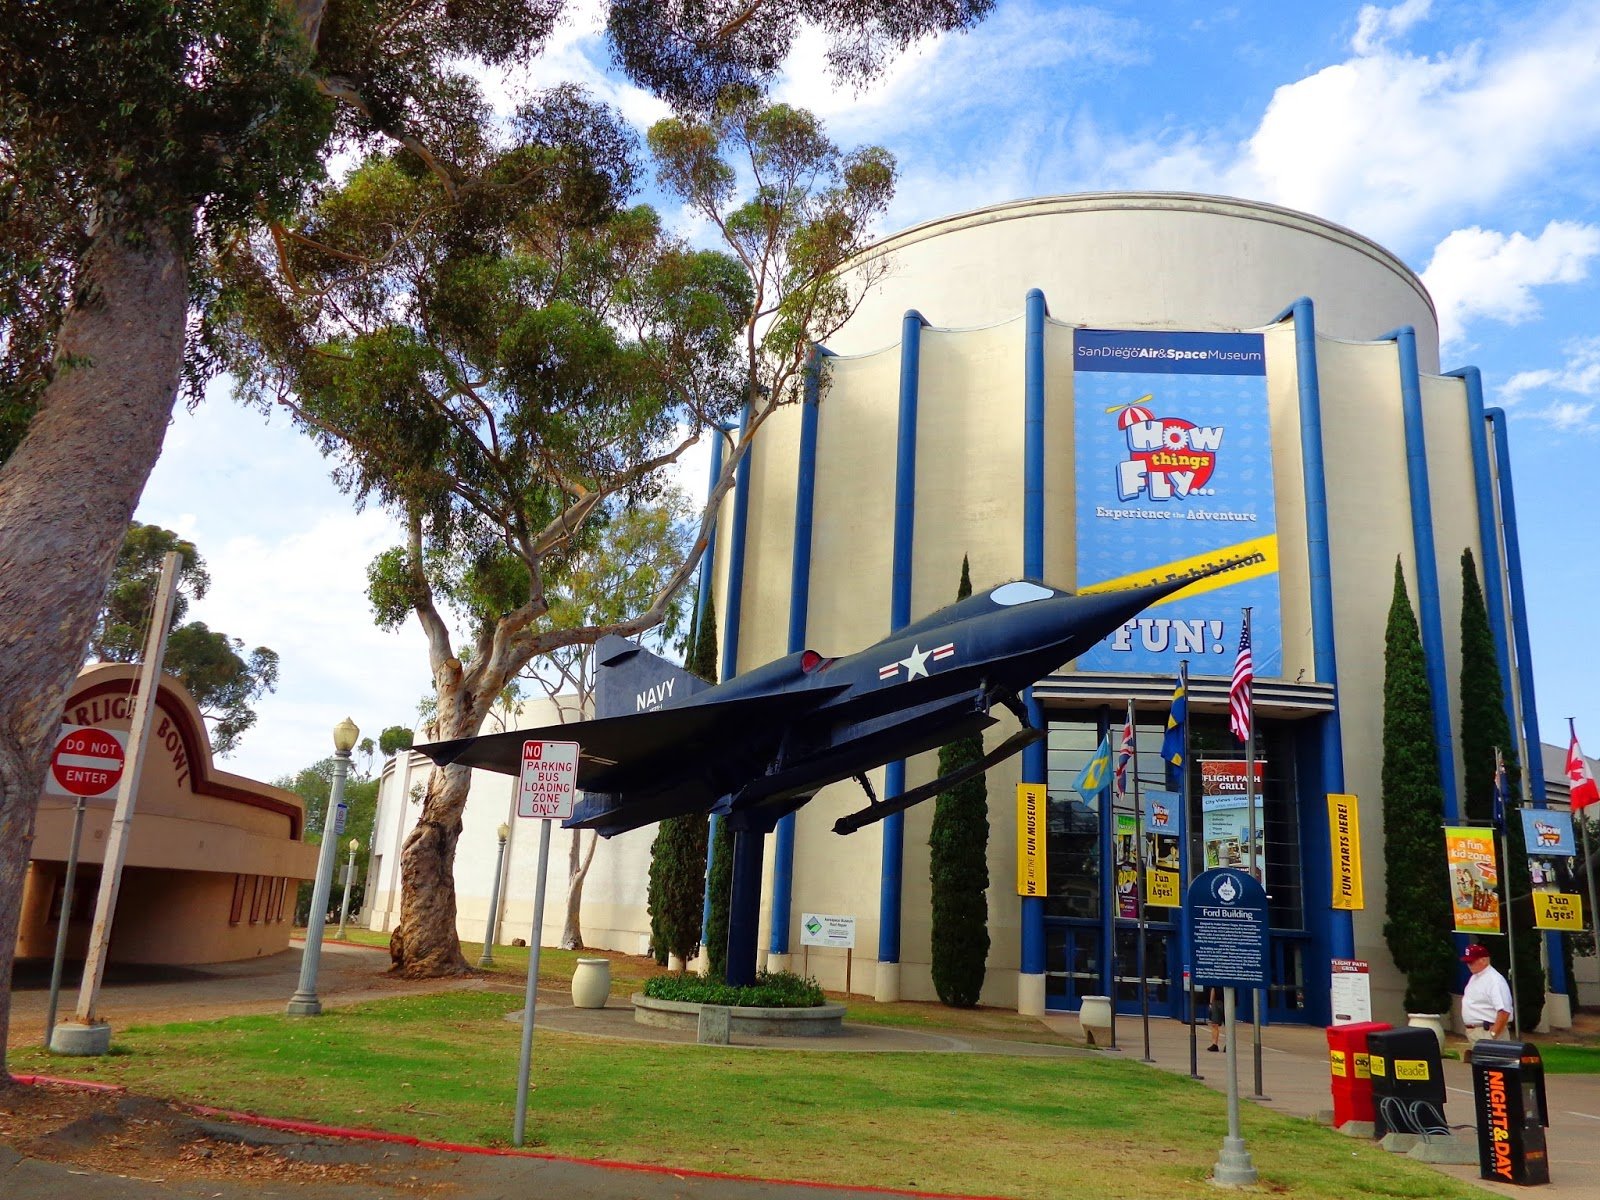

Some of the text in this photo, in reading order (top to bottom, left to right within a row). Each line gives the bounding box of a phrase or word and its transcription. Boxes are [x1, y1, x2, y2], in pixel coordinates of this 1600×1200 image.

[1128, 419, 1224, 451] HOW
[1152, 452, 1209, 468] things
[1096, 507, 1170, 520] Experience
[1187, 508, 1256, 521] Adventure
[1111, 618, 1225, 654] FUN!
[636, 678, 675, 711] NAVY
[66, 739, 117, 755] DO NOT
[157, 717, 189, 788] BOWL
[525, 745, 541, 758] NO
[527, 761, 572, 772] PARKING
[66, 770, 108, 784] ENTER
[538, 772, 559, 782] BUS
[525, 782, 570, 792] LOADING
[533, 793, 560, 803] ZONE
[532, 803, 559, 814] ONLY
[1027, 792, 1036, 836] MUSEUM!
[1337, 803, 1349, 834] HERE!
[1027, 837, 1036, 856] FUN
[1467, 840, 1483, 850] fun
[1340, 836, 1351, 874] STARTS
[1451, 850, 1491, 861] kid zone
[1155, 873, 1169, 882] Fun
[1027, 880, 1036, 895] WE
[1152, 887, 1173, 898] Ages!
[1342, 875, 1352, 897] FUN
[1548, 895, 1569, 905] Fun
[1203, 908, 1253, 920] Ford Building
[1545, 910, 1574, 921] Ages!
[1397, 1063, 1427, 1076] Reader
[1488, 1071, 1512, 1180] NIGHT&DAY
